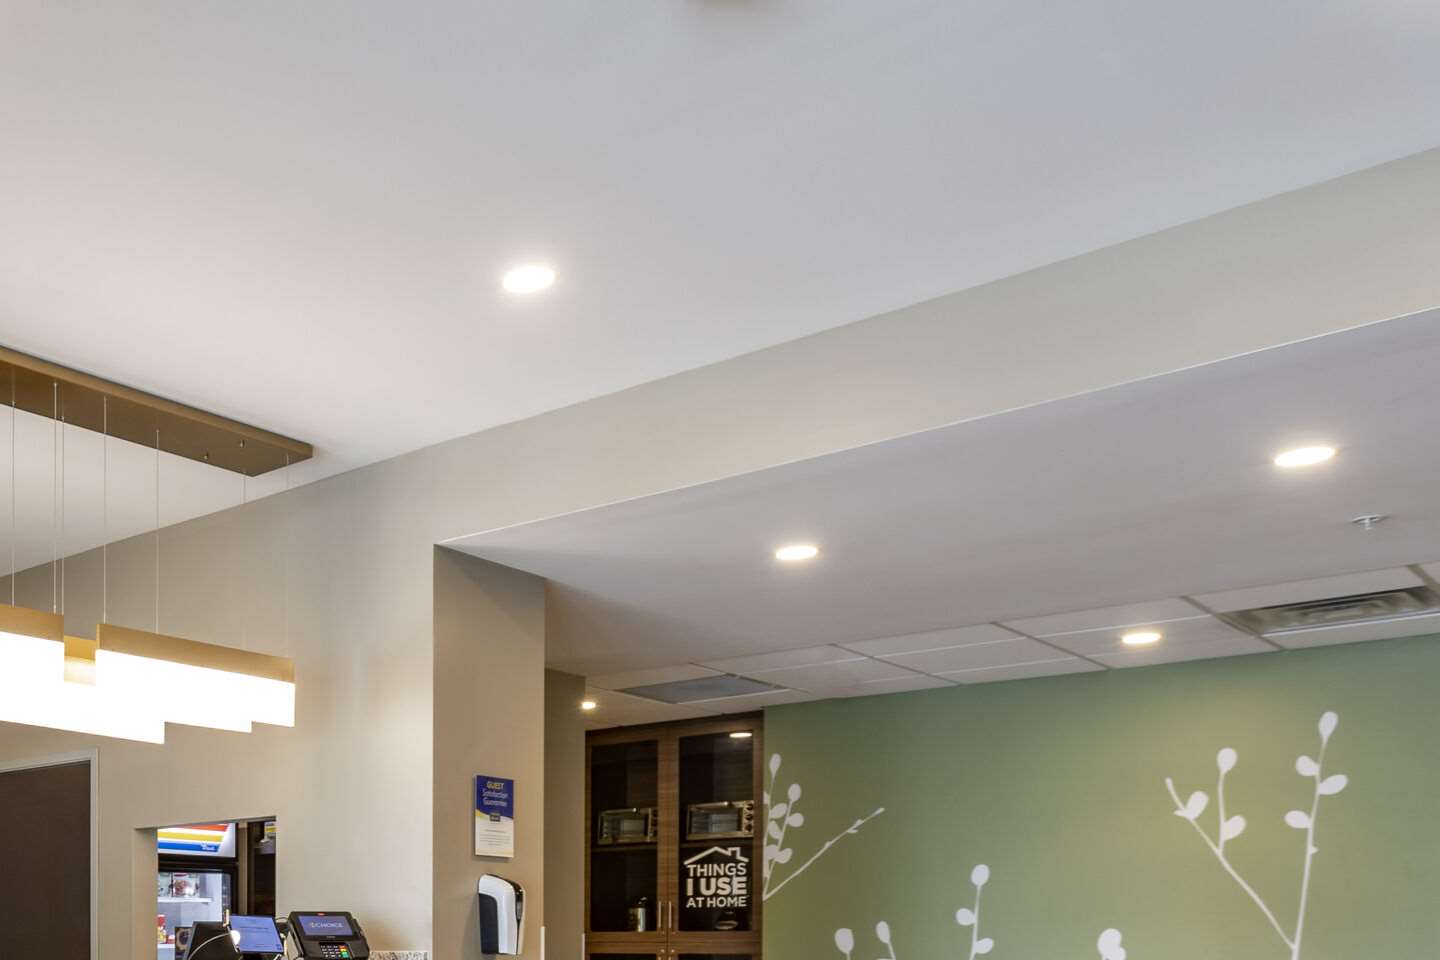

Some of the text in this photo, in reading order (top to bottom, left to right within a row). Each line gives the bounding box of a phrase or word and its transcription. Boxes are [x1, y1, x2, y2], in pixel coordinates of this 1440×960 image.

[687, 862, 747, 877] THINGS
[687, 876, 747, 896] I USE
[686, 896, 747, 908] AT HOME
